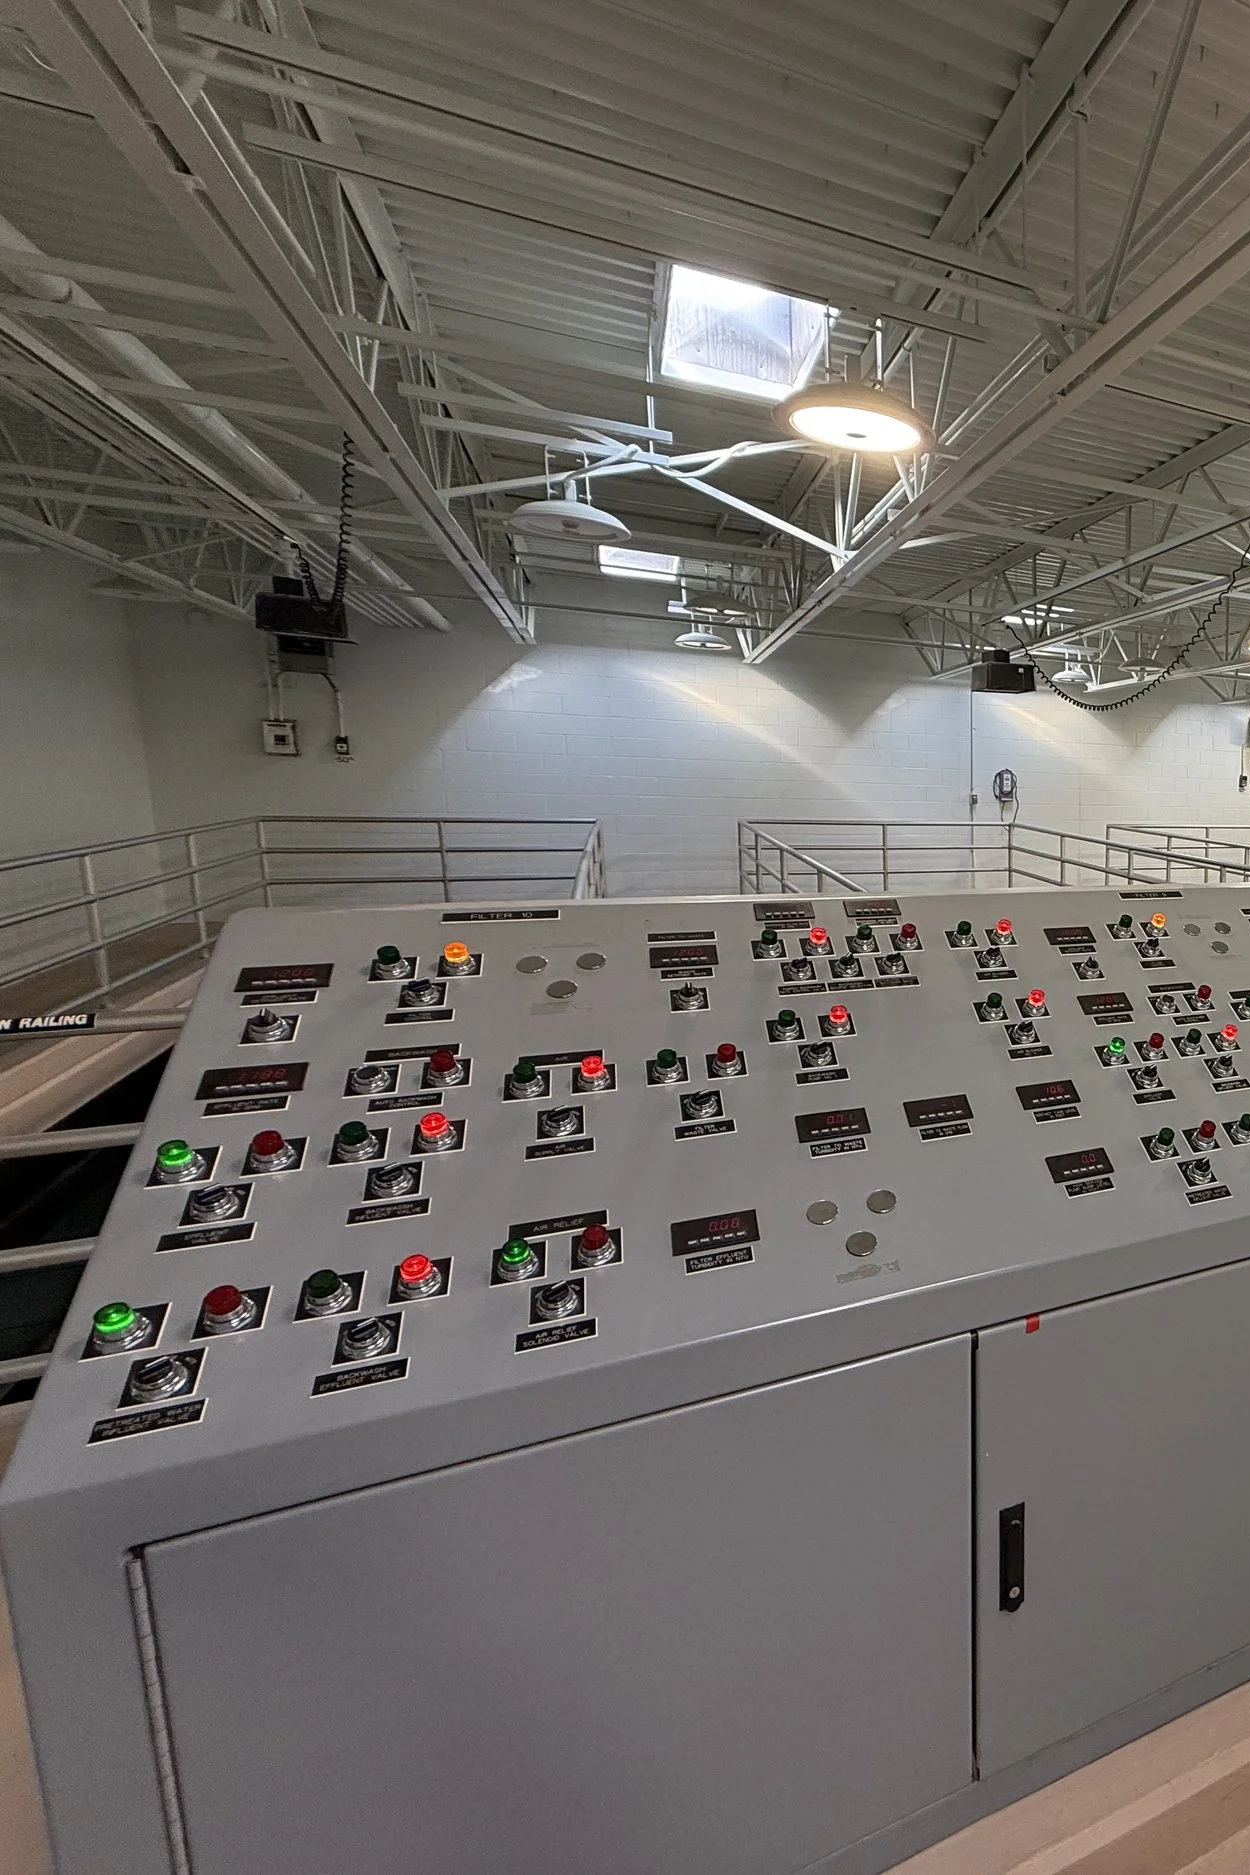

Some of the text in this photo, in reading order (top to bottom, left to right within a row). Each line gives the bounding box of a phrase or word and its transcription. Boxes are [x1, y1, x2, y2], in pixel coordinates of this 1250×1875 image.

[470, 912, 513, 920] FILTER
[19, 1014, 88, 1030] RAILING
[388, 1101, 420, 1109] CONTROL
[398, 1095, 438, 1103] BACKWASH
[684, 1128, 705, 1136] WASTE
[365, 1203, 414, 1215] BACKWASH
[396, 1206, 421, 1215] VALVE
[533, 1218, 584, 1233] AIR RELIEF
[184, 1228, 229, 1241] EFFLUENT
[689, 1249, 748, 1265] FILTER EFFLUENT
[691, 1260, 723, 1270] TURBIDITY
[522, 1328, 590, 1348] SOLENOID VALVE
[535, 1325, 578, 1339] AIR RELIEF
[319, 1369, 400, 1391] EFFLUENT VALVE
[336, 1366, 387, 1382] BACKWASH
[94, 1403, 202, 1432] PRETREATED WATER
[101, 1411, 190, 1437] INFLUENT VALVE
